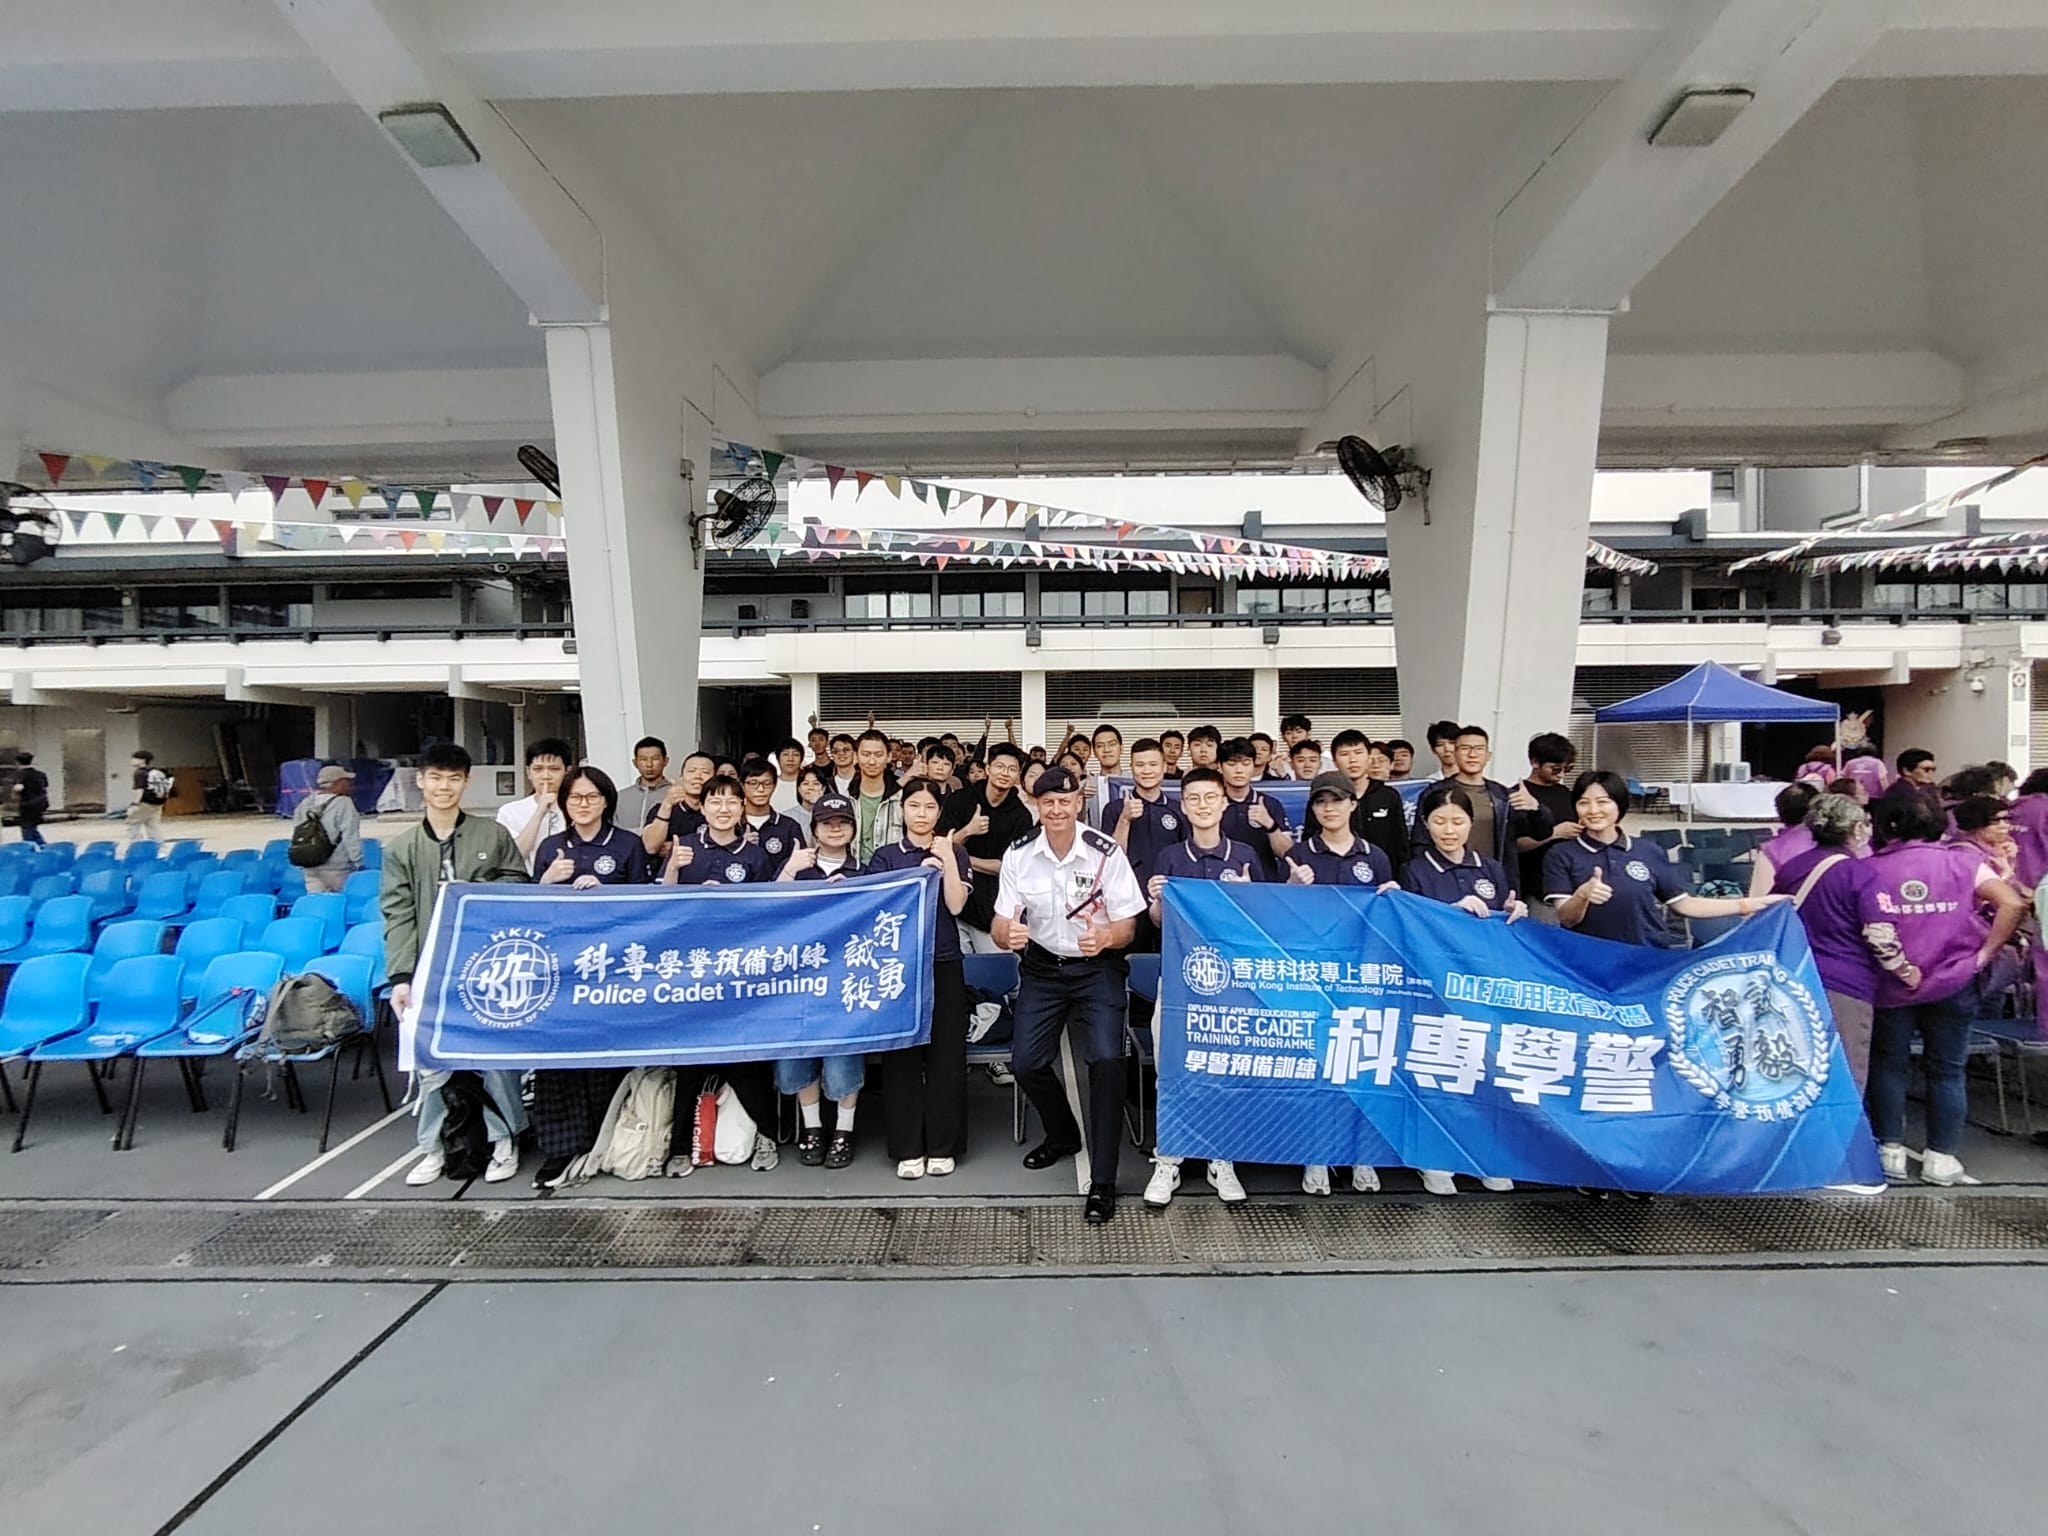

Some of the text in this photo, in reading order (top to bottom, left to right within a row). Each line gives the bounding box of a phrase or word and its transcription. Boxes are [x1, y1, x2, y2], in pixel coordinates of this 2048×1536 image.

[490, 928, 546, 942] HKIT
[460, 951, 480, 981] HONG
[1231, 957, 1404, 986] 香港科技專上書院
[1667, 972, 1699, 1002] POLICE
[1692, 958, 1737, 978] CADET
[456, 983, 474, 1011] KONG
[572, 974, 828, 1005] Police Cadet Training
[1231, 979, 1257, 991] Hong
[1259, 980, 1284, 992] Kong
[1286, 981, 1322, 993] Institute
[1324, 984, 1334, 992] of
[1335, 984, 1384, 996] Technology
[471, 1010, 524, 1029] INSTITUTE
[1187, 1003, 1218, 1014] DIPLOMA
[1219, 1005, 1230, 1014] OF
[1229, 1006, 1260, 1017] APPLIED
[1260, 1008, 1300, 1018] EDUCATION
[1186, 1012, 1316, 1038] POLICE CADET
[1185, 1031, 1316, 1050] TRAINING PROGRAMME
[1184, 1049, 1318, 1080] 學警預備訓練
[1322, 1006, 1666, 1113] 科專學警
[691, 1126, 702, 1166] Coffee
